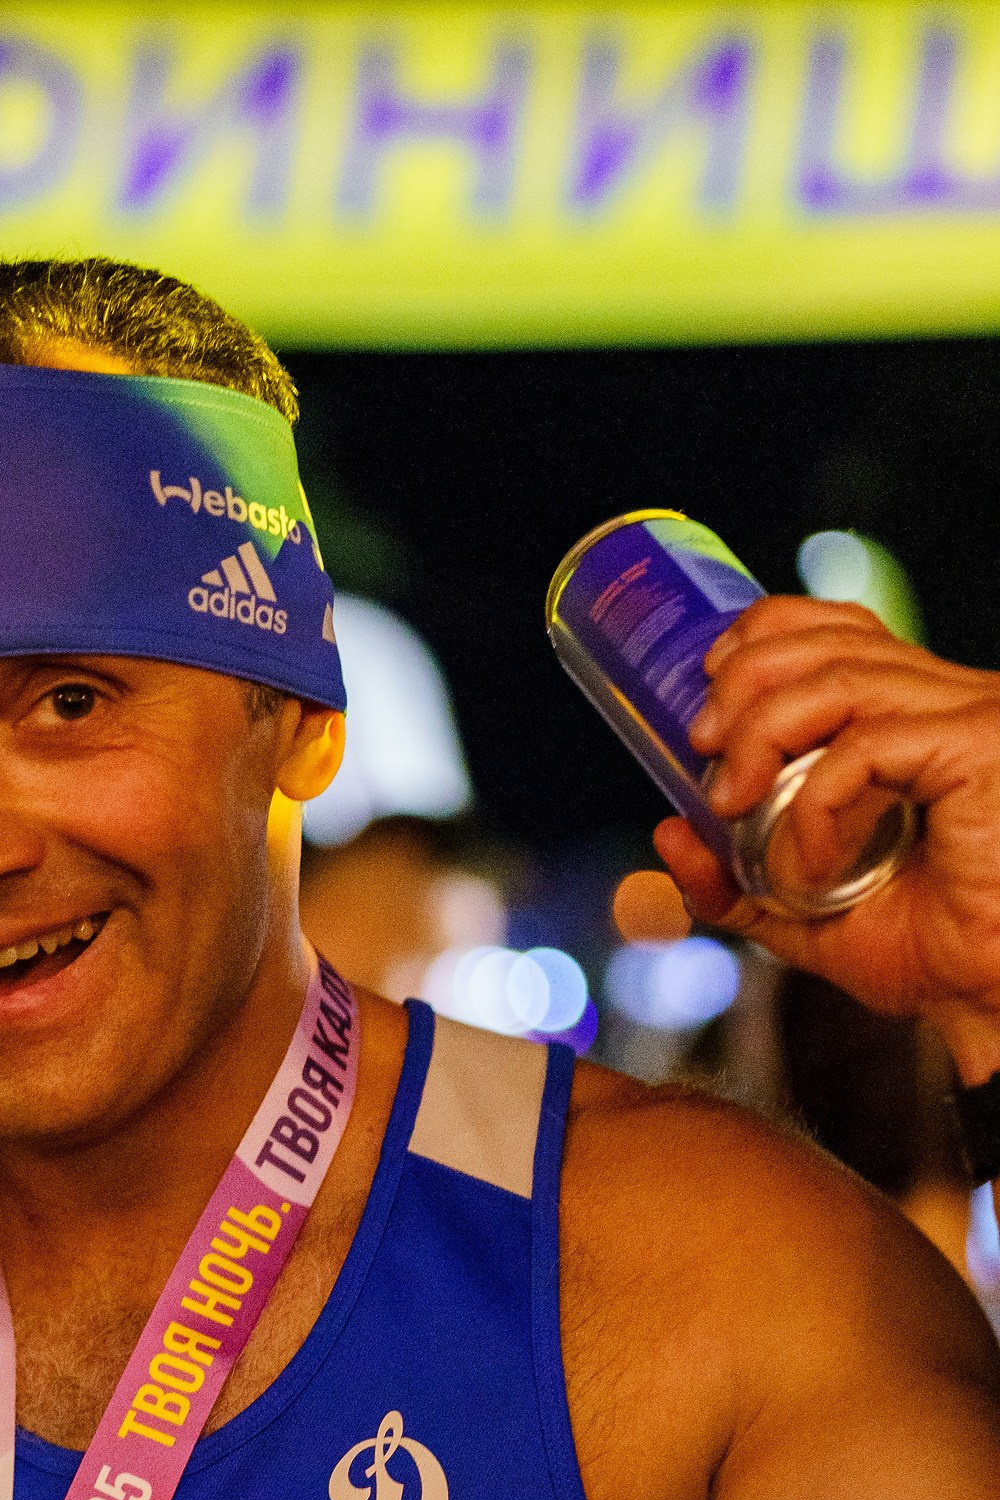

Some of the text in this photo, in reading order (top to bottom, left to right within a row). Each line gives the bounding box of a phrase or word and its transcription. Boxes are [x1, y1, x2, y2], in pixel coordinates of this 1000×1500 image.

[150, 470, 301, 545] Webasto
[188, 585, 288, 635] adidas
[255, 1055, 345, 1184] ТВОЯ
[118, 1321, 222, 1448] ТВОЯ
